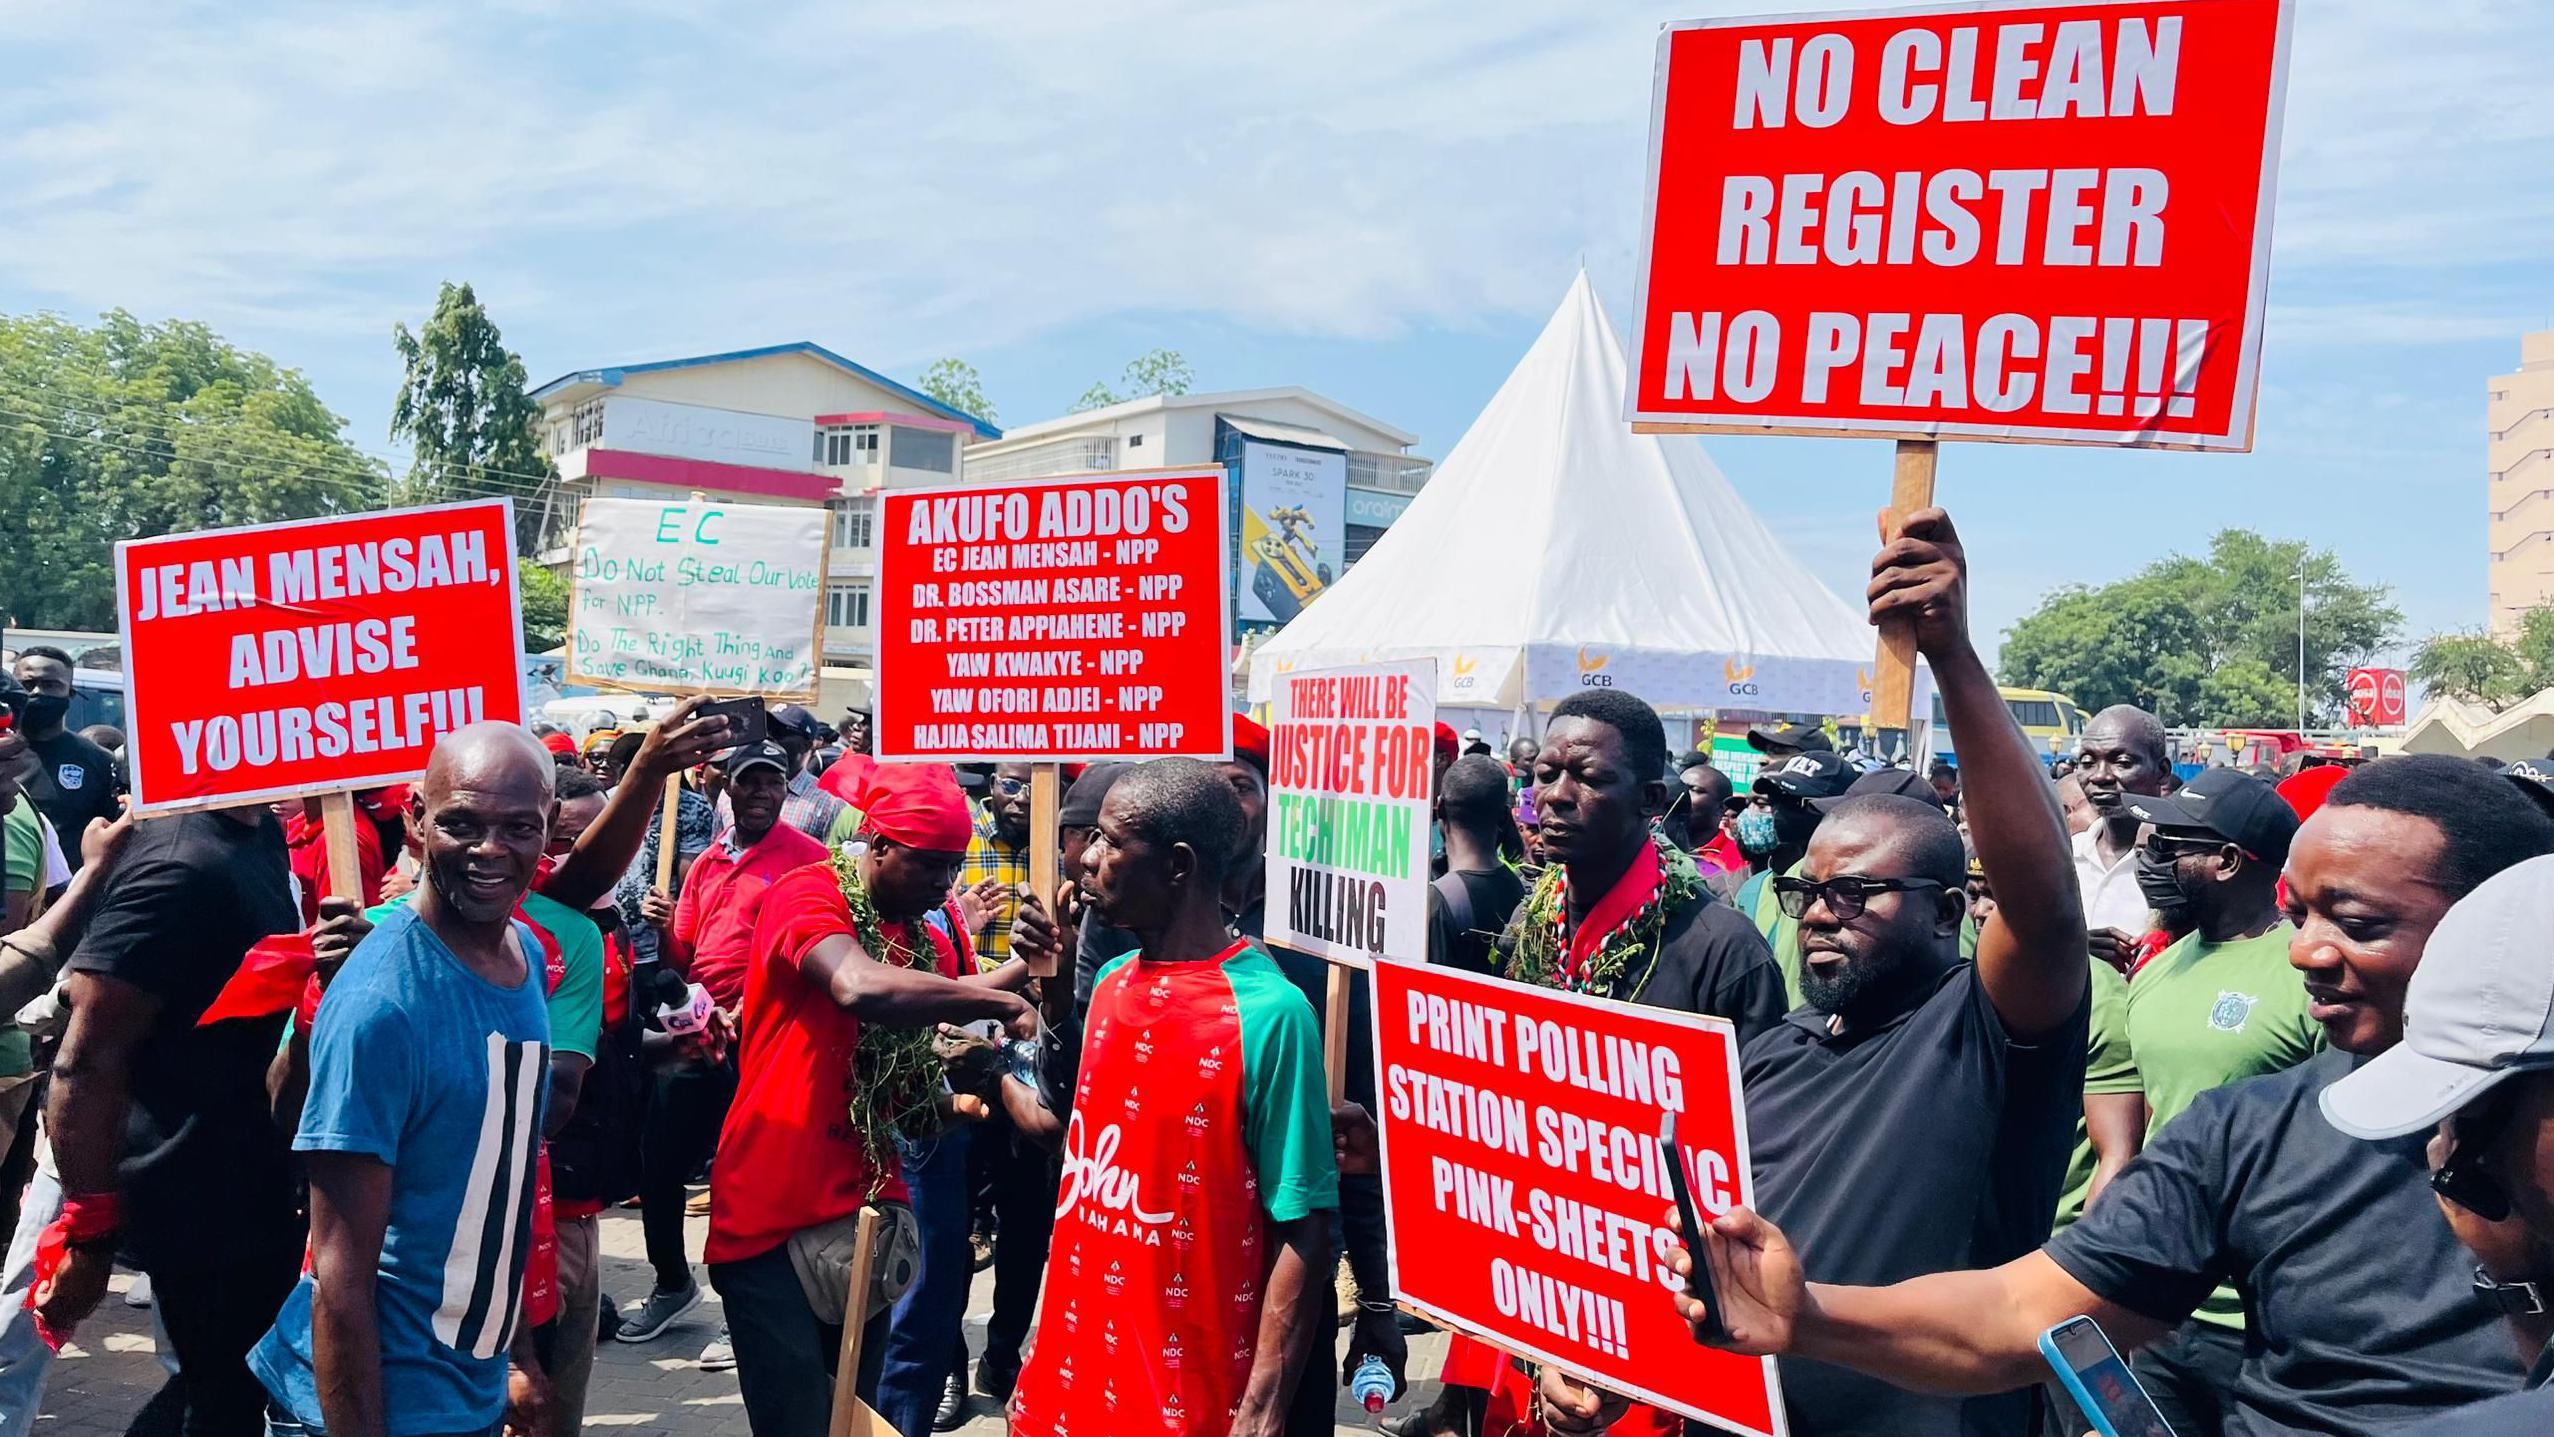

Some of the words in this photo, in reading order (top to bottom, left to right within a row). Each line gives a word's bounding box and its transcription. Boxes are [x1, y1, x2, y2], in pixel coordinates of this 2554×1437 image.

[1733, 33, 1855, 130] NO
[1877, 15, 2183, 126] CLEAN
[1716, 167, 2169, 267] REGISTER
[1663, 309, 1781, 404] NO
[1801, 311, 2209, 420] PEACE!!!
[1272, 467, 1301, 479] SPARK
[656, 508, 724, 544] EC
[907, 492, 1029, 545] AKUFO
[1038, 483, 1189, 539] ADDO'S
[583, 547, 617, 581] Do
[626, 557, 665, 582] Not
[677, 557, 740, 587] Steal
[750, 560, 787, 587] Our
[787, 566, 820, 590] Vote
[933, 547, 958, 573] EC
[961, 545, 1007, 571] JEAN
[1011, 540, 1098, 569] MENSAH
[1116, 538, 1159, 565] NPP
[137, 555, 257, 621] JEAN
[268, 530, 500, 608] MENSAH,
[582, 588, 606, 612] for
[912, 583, 945, 609] DR.
[948, 579, 1048, 607] BOSSMAN
[1052, 576, 1121, 604] ASARE
[1139, 574, 1183, 601] NPP
[910, 618, 942, 644] DR.
[946, 616, 1004, 642] PETER
[1008, 612, 1124, 641] APPIAHENE
[1141, 611, 1186, 638] NPP
[229, 615, 419, 689] ADVISE
[577, 628, 600, 654] Do
[610, 627, 637, 652] The
[647, 631, 705, 663] Right
[713, 631, 761, 660] Thing
[764, 646, 794, 661] And
[581, 656, 627, 677] Save
[946, 652, 991, 678] YAW
[994, 650, 1082, 677] KWAKYE
[1100, 649, 1144, 675] NPP
[1453, 676, 1474, 688] GCB
[1581, 673, 1613, 688] GCB
[1729, 682, 1759, 696] GCB
[930, 688, 974, 713] YAW
[978, 687, 1038, 714] OFORI
[1042, 686, 1100, 713] ADJEI
[1118, 685, 1163, 712] NPP
[1290, 677, 1336, 719] THERE
[1340, 674, 1381, 719] WILL
[1384, 674, 1409, 719] BE
[171, 687, 484, 775] YOURSELF!!!
[913, 723, 970, 749] HAJIA
[971, 723, 1050, 750] SALIMA
[1052, 723, 1121, 749] TIJANI
[1139, 722, 1184, 749] NPP
[1270, 723, 1367, 795] JUSTICE
[1371, 724, 1430, 800] FOR
[1277, 793, 1412, 879] TECHIMAN
[1289, 866, 1387, 954] KILLING
[545, 964, 566, 974] NDC
[1149, 986, 1172, 999] NDC
[1220, 1004, 1238, 1015] ND
[1135, 1040, 1154, 1055] NDC
[1407, 989, 1507, 1067] PRINT
[1514, 1013, 1685, 1113] POLLING
[1198, 1057, 1224, 1070] NDC
[1124, 1098, 1141, 1112] NDC
[1185, 1114, 1210, 1128] NDC
[1388, 1063, 1529, 1158] STATION
[1535, 1105, 1733, 1217] SPECIC
[1055, 1108, 1176, 1224] John
[1177, 1172, 1201, 1186] NDC
[1171, 1228, 1195, 1241] NDC
[1432, 1156, 1685, 1293] PINK-SHEETS
[1103, 1273, 1126, 1286] NDC
[1165, 1287, 1189, 1298] NDC
[1234, 1292, 1254, 1303] NDC
[1491, 1257, 1629, 1360] ONLY!!!
[1162, 1347, 1184, 1358] NDC
[1162, 1407, 1186, 1419] NDC
